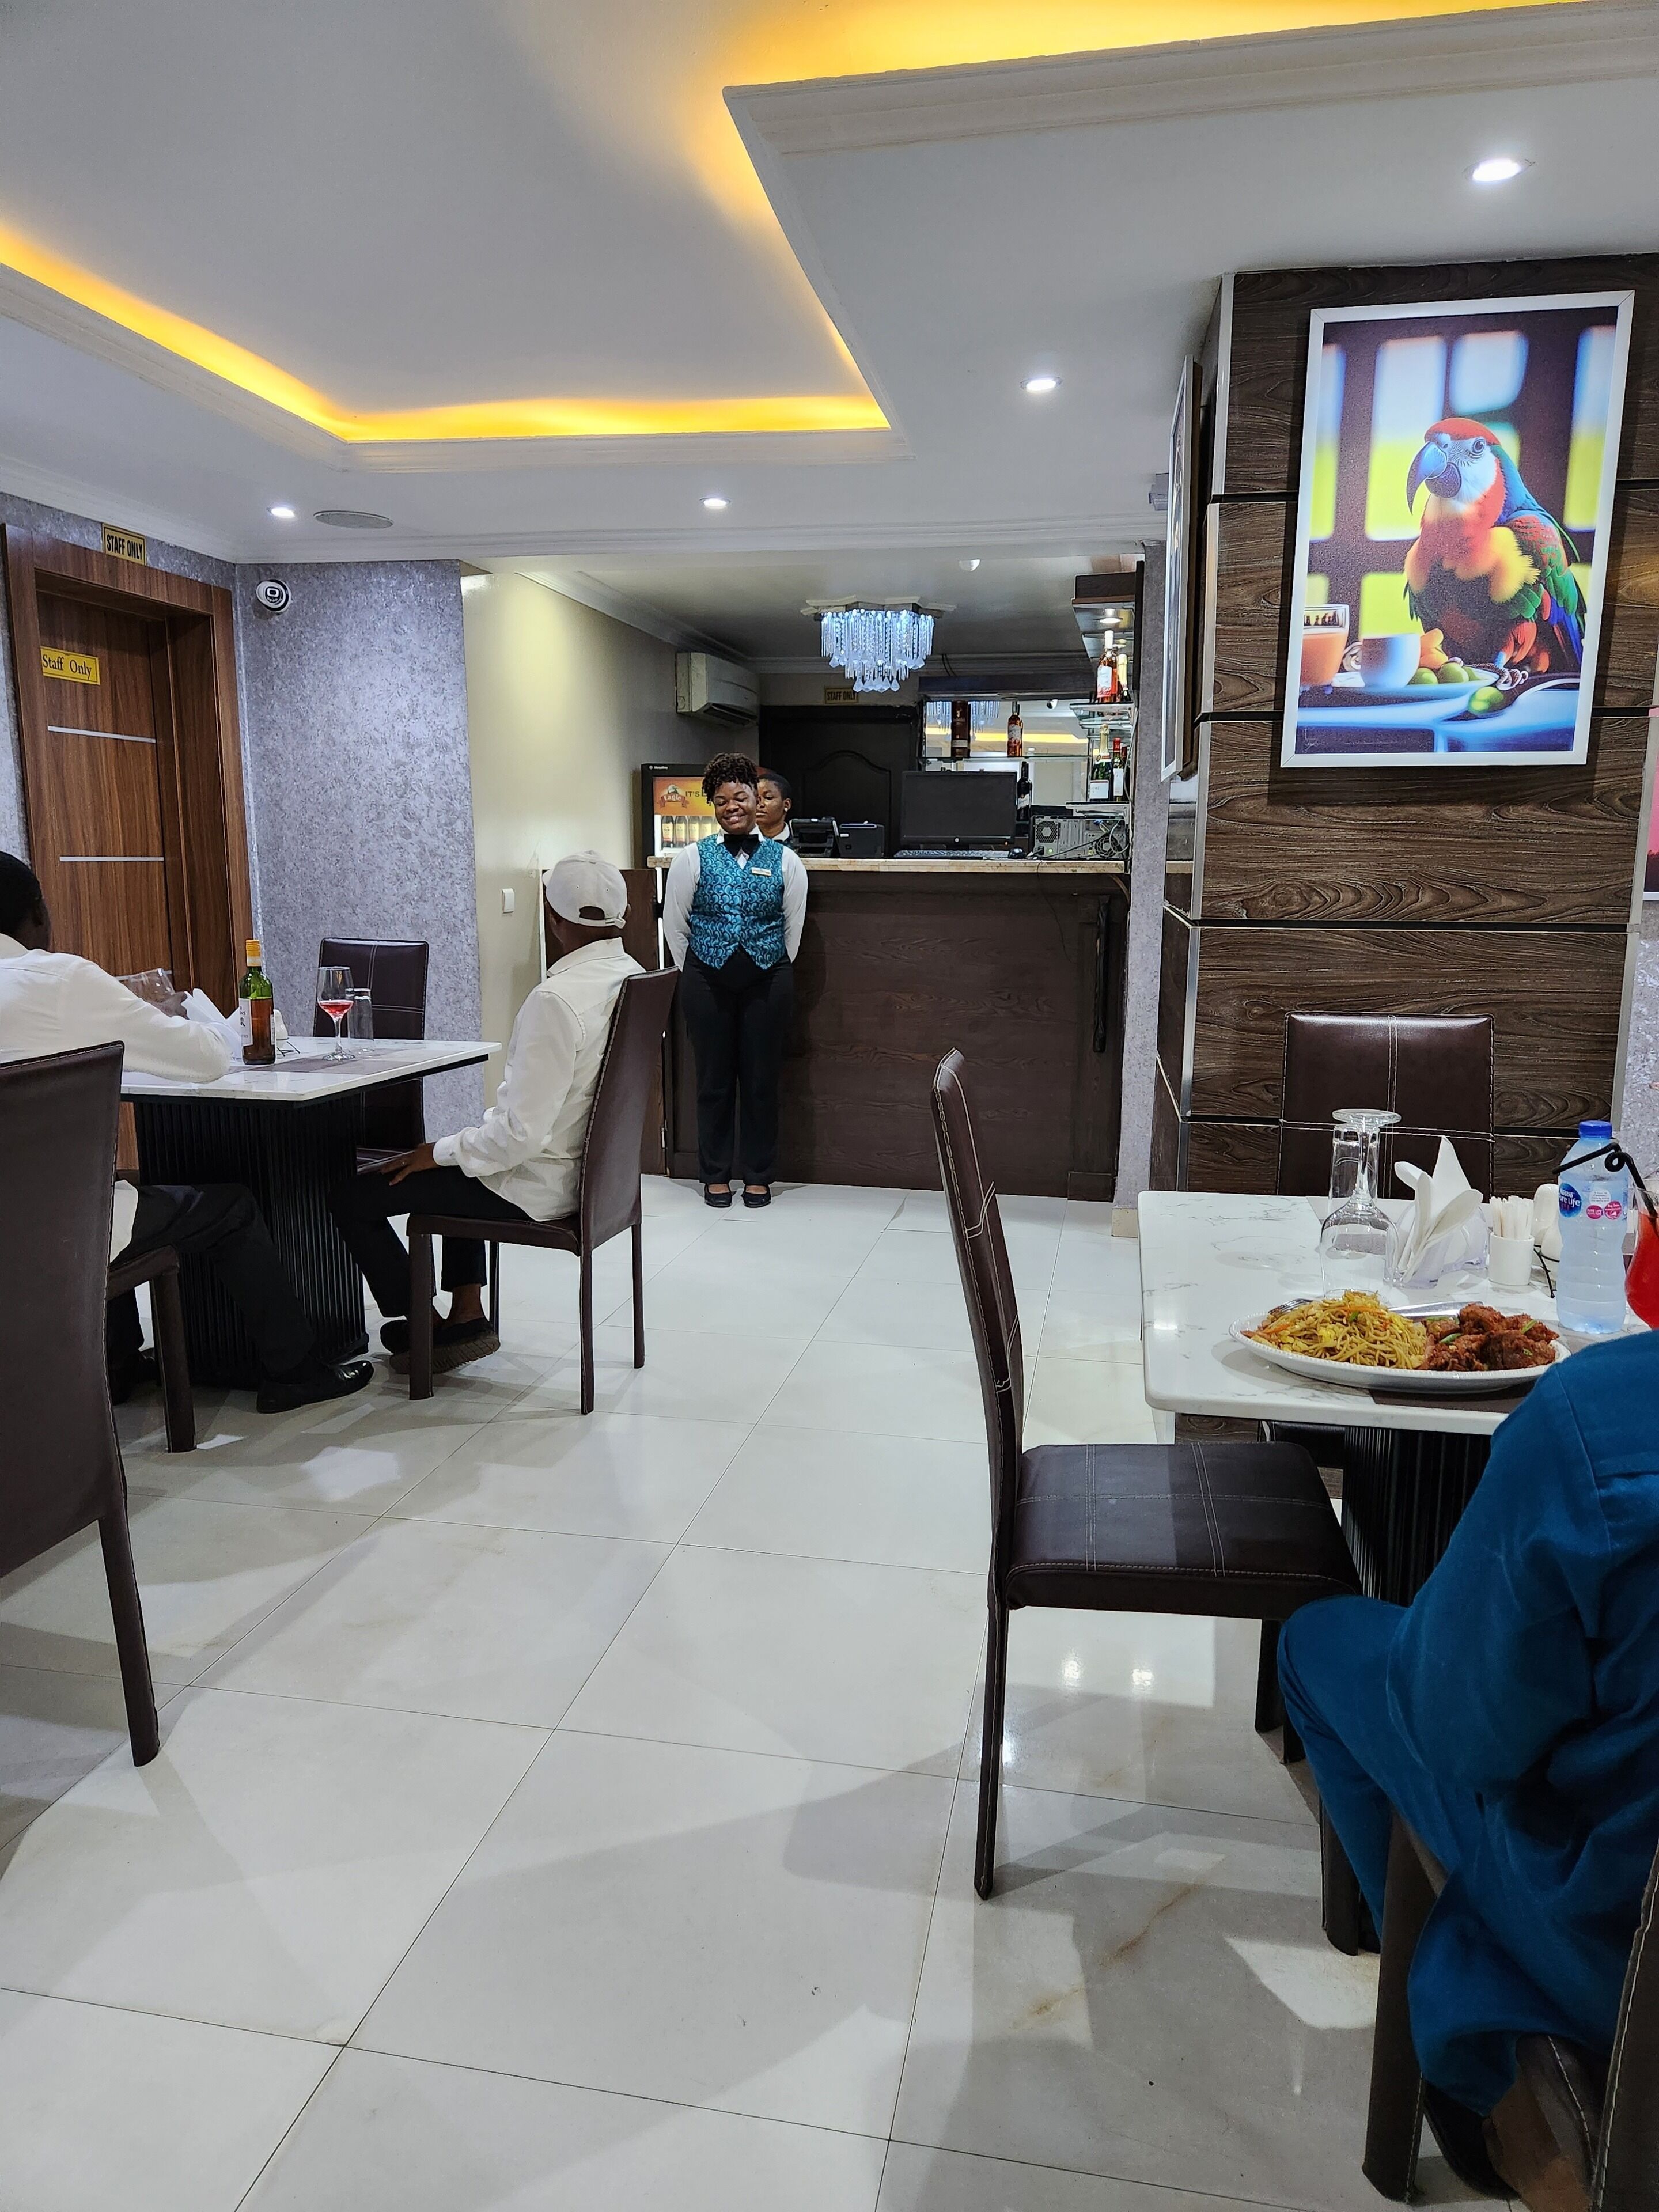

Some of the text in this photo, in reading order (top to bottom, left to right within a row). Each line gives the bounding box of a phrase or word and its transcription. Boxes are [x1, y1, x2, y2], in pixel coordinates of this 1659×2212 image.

[107, 533, 143, 560] STAFF ONLY
[42, 654, 92, 680] Staff Only
[663, 793, 682, 801] Eagle
[1568, 1197, 1581, 1208] Life
